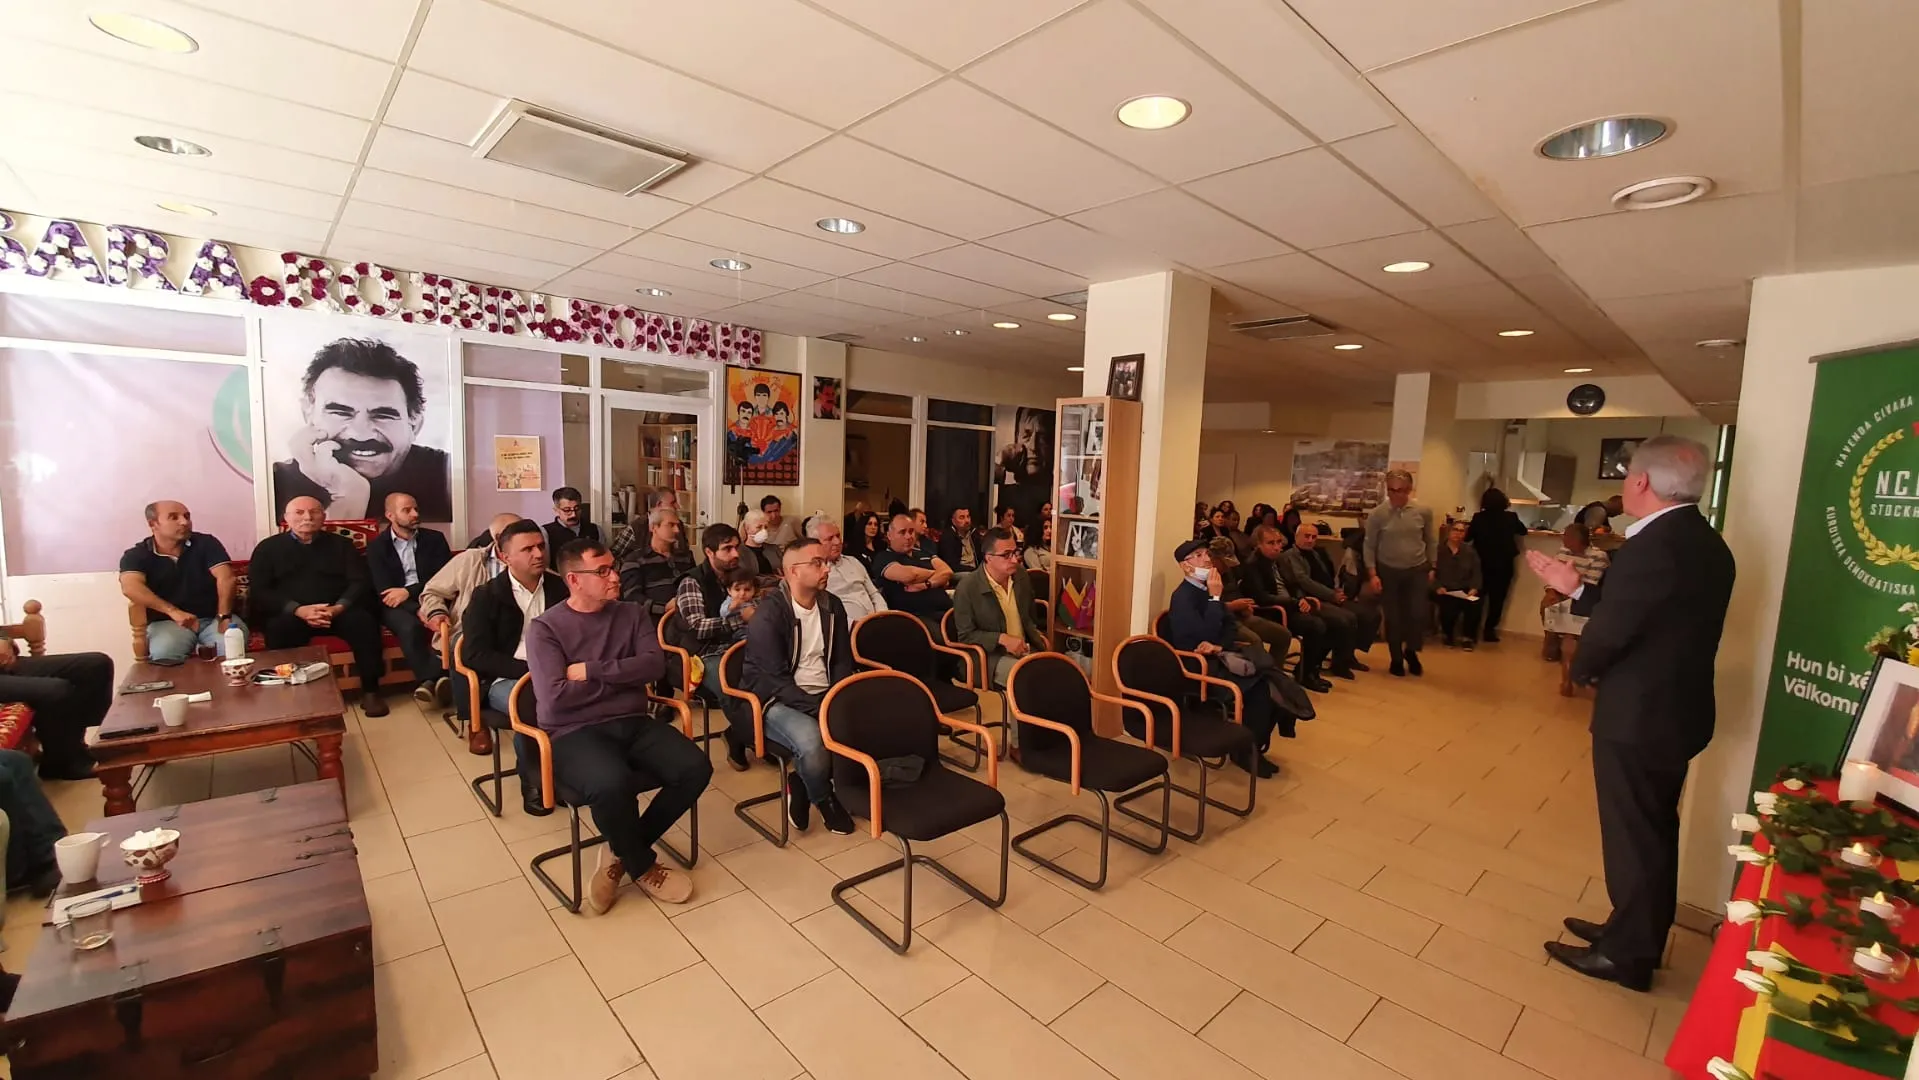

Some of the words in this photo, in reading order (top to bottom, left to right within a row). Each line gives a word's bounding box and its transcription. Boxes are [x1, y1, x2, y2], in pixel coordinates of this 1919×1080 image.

[1835, 420, 1872, 468] NAVENDA
[1873, 394, 1913, 423] CIVAKA
[1875, 470, 1919, 497] NC
[1826, 505, 1847, 558] KURDISKA
[1843, 556, 1916, 596] DEMOKRATISKA
[1786, 650, 1823, 677] Hun
[1826, 661, 1846, 684] bi
